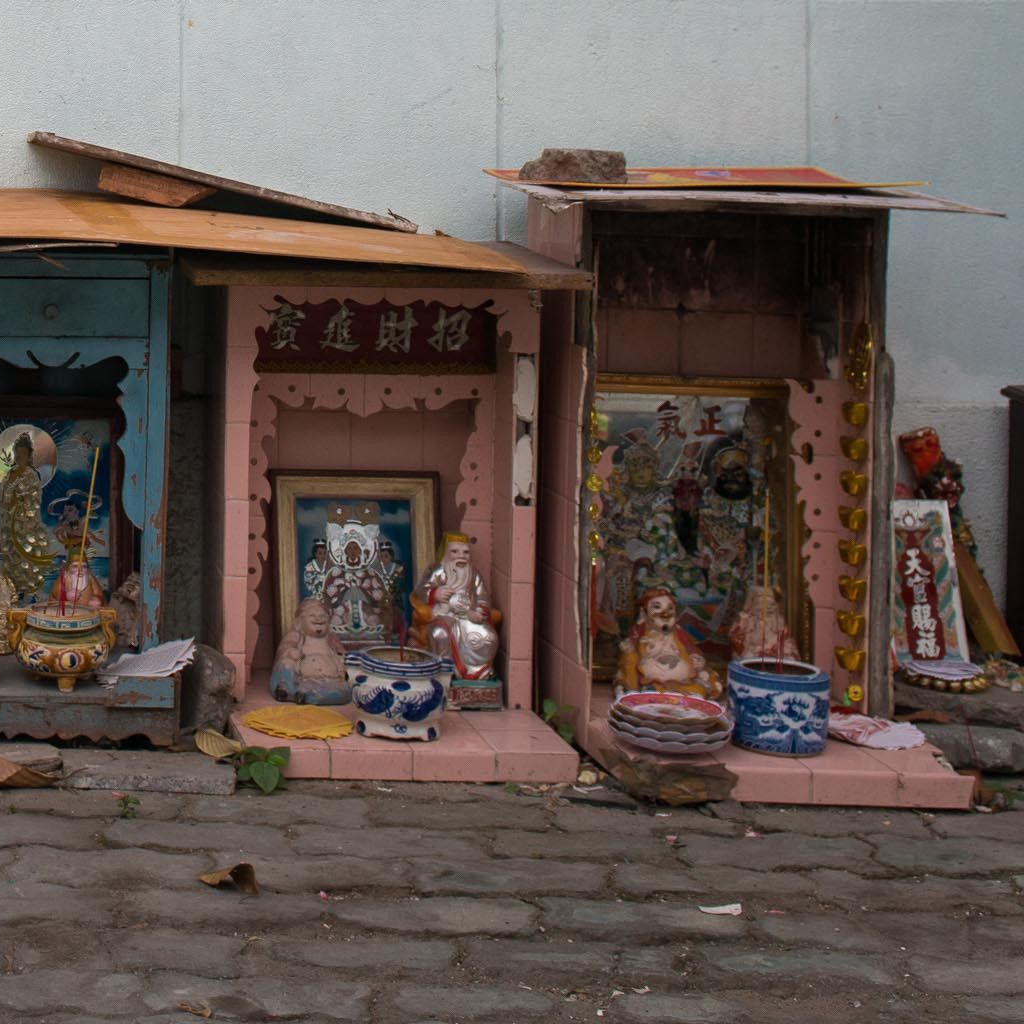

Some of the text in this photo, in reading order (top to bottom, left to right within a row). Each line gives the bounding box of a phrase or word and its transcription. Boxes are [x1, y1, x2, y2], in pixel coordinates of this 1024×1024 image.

[264, 303, 473, 354] 招財進寶
[904, 547, 941, 659] 天官賜福
